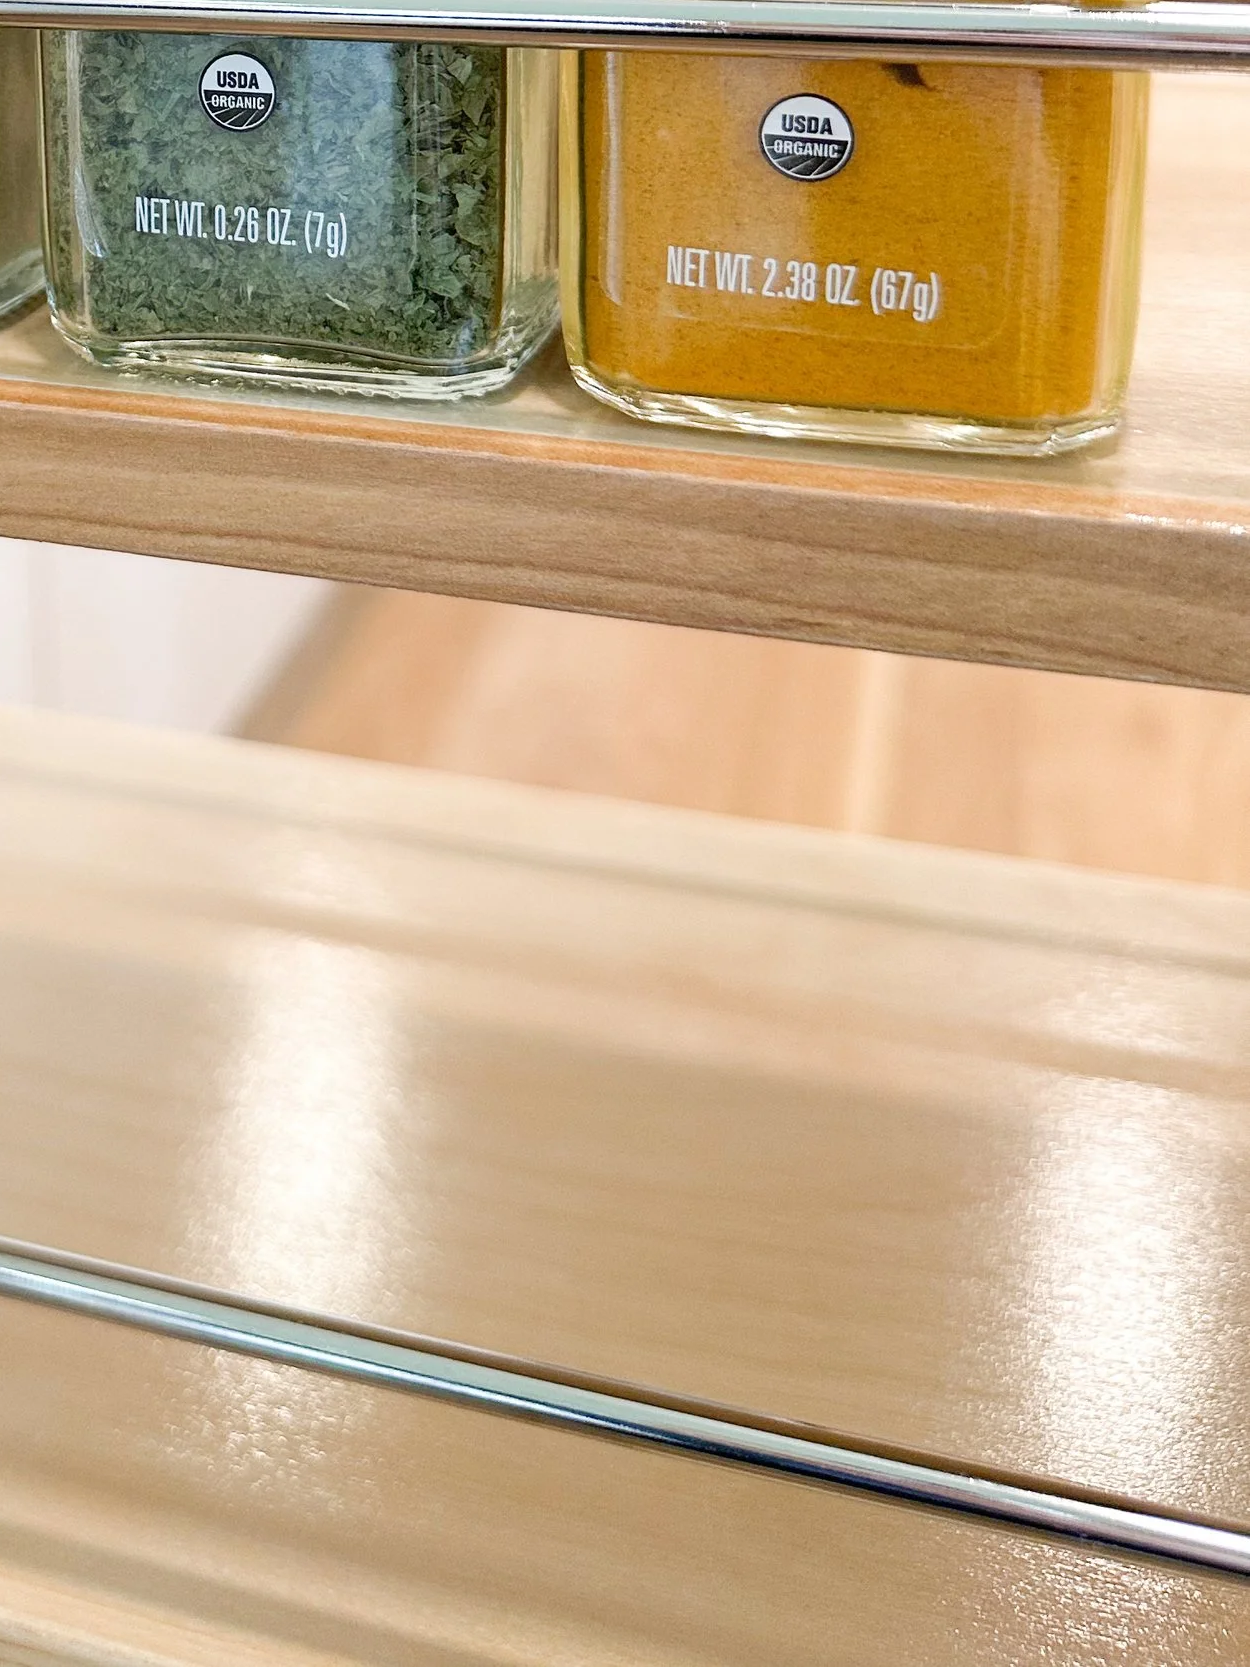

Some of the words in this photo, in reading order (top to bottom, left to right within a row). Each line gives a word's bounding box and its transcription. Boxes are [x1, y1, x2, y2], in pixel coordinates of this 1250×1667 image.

[216, 70, 260, 90] USDA
[210, 93, 266, 111] ORGANIC
[780, 113, 834, 136] USDA
[772, 138, 840, 159] ORGANIC
[135, 196, 171, 234] NET
[174, 200, 208, 239] WT.
[214, 204, 260, 244] 0.26
[266, 207, 297, 247] OZ.
[304, 209, 348, 259] (7g)
[666, 245, 711, 288] NET
[714, 250, 754, 295] WT.
[761, 257, 818, 302] 2.38
[824, 262, 862, 307] OZ.
[870, 266, 941, 324] (67g)
